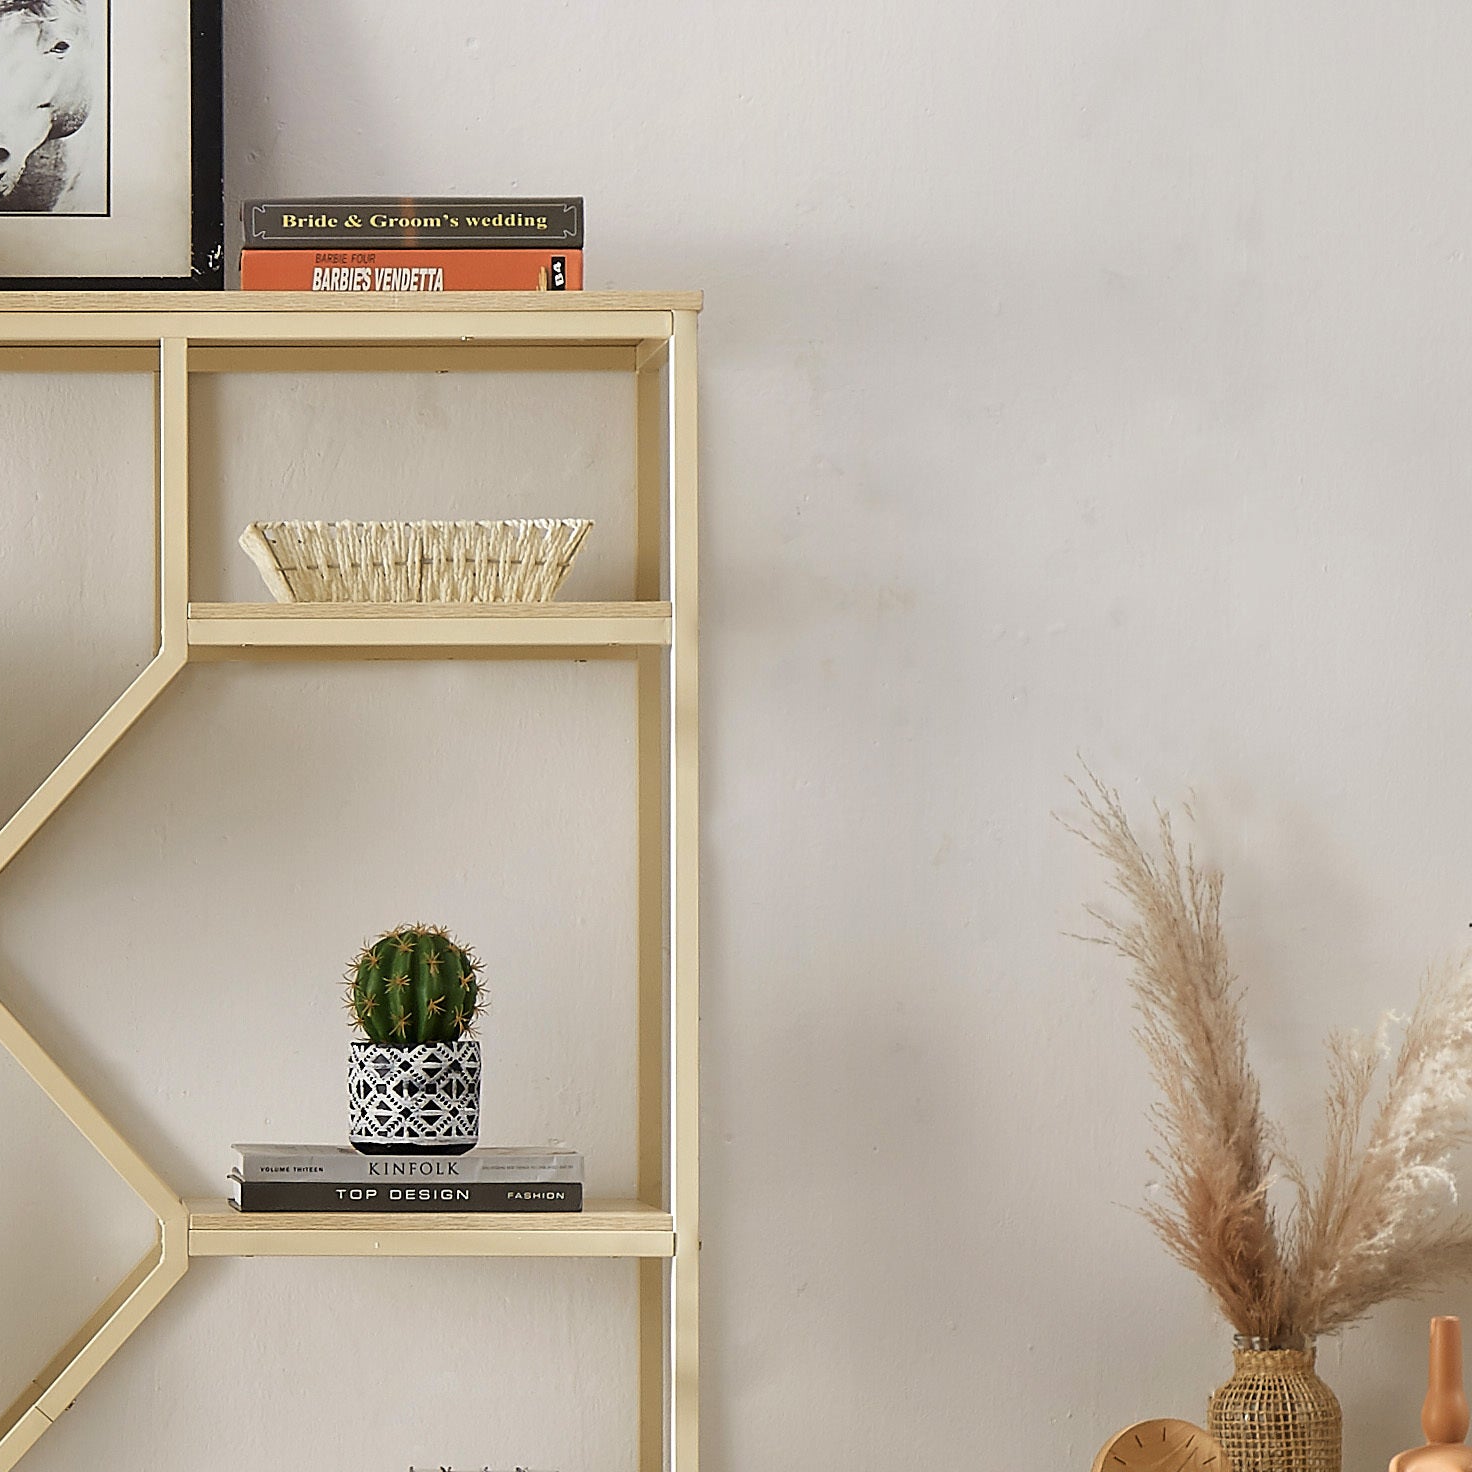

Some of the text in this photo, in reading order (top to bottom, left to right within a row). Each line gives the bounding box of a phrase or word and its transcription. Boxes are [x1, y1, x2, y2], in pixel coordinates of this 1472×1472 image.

[282, 214, 548, 230] Bride & Groom's wedding
[315, 254, 376, 263] BARBIE FOUR
[375, 268, 444, 291] VENDETTA
[369, 1161, 460, 1176] KINFOLK
[336, 1188, 565, 1200] TOP DESIGN FASHION
